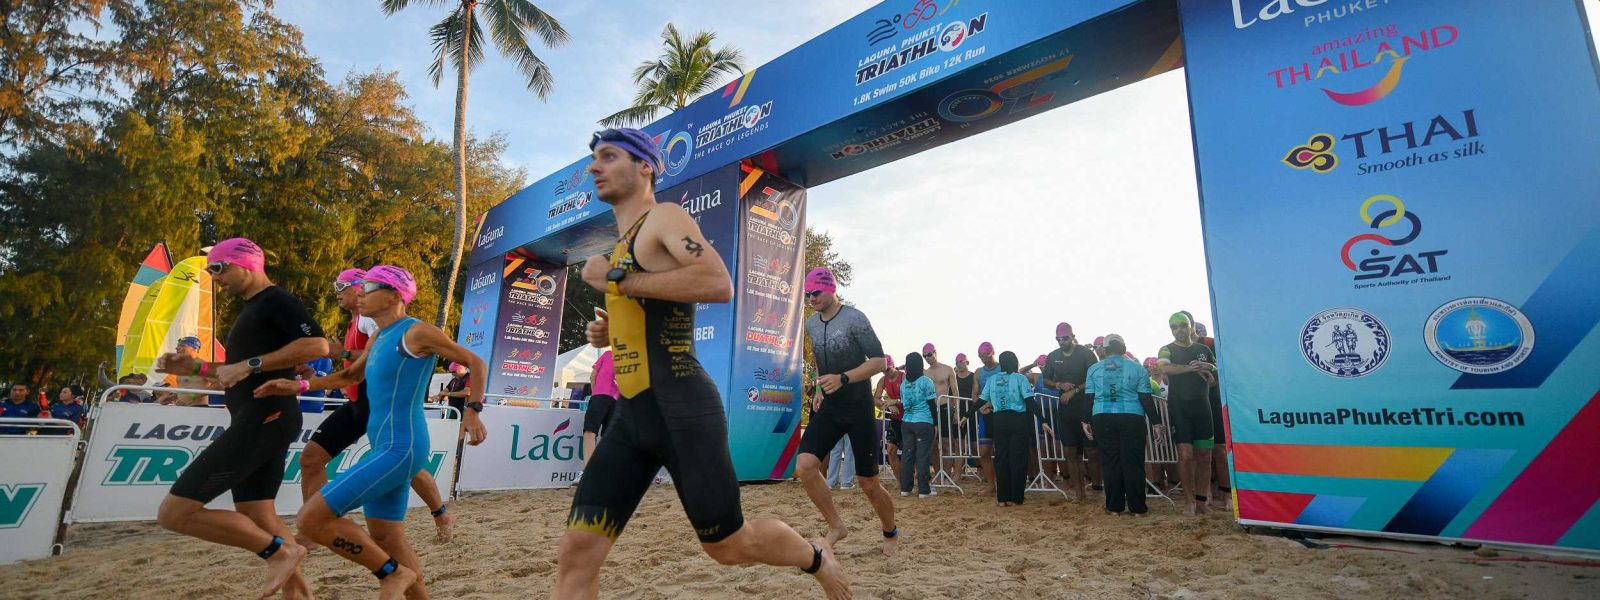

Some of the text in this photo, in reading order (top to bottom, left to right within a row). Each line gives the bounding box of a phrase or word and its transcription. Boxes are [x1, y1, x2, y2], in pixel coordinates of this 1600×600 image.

[1304, 0, 1391, 28] PHUKE
[856, 12, 988, 86] TRIATHLON
[858, 22, 943, 67] LAGUNA PHUKET
[1311, 23, 1400, 56] amazing
[1267, 24, 1459, 89] THAILAND
[853, 45, 986, 106] 1.8K Swim 50K Bike 12K Run
[695, 100, 774, 149] TRIATHLON
[698, 105, 748, 134] LAGUNA PHUKET
[1340, 108, 1480, 159] THAI
[694, 150, 705, 161] THE
[707, 143, 724, 155] RACE
[725, 138, 736, 146] OF
[737, 121, 769, 141] LEGENDS
[1357, 141, 1485, 176] Smooth as silk
[547, 191, 593, 219] TRIATHLON
[1354, 249, 1449, 281] SAT
[1354, 281, 1376, 290] Sports
[1377, 278, 1410, 287] Authority
[1420, 275, 1451, 284] Thailand
[746, 331, 793, 349] DUATHLON
[1434, 350, 1459, 368] MINISTRY
[1501, 361, 1514, 370] AND
[1513, 346, 1530, 365] SPORTS
[124, 423, 230, 441] LAGUN
[1257, 407, 1525, 428] LagunaPhuketTri.com
